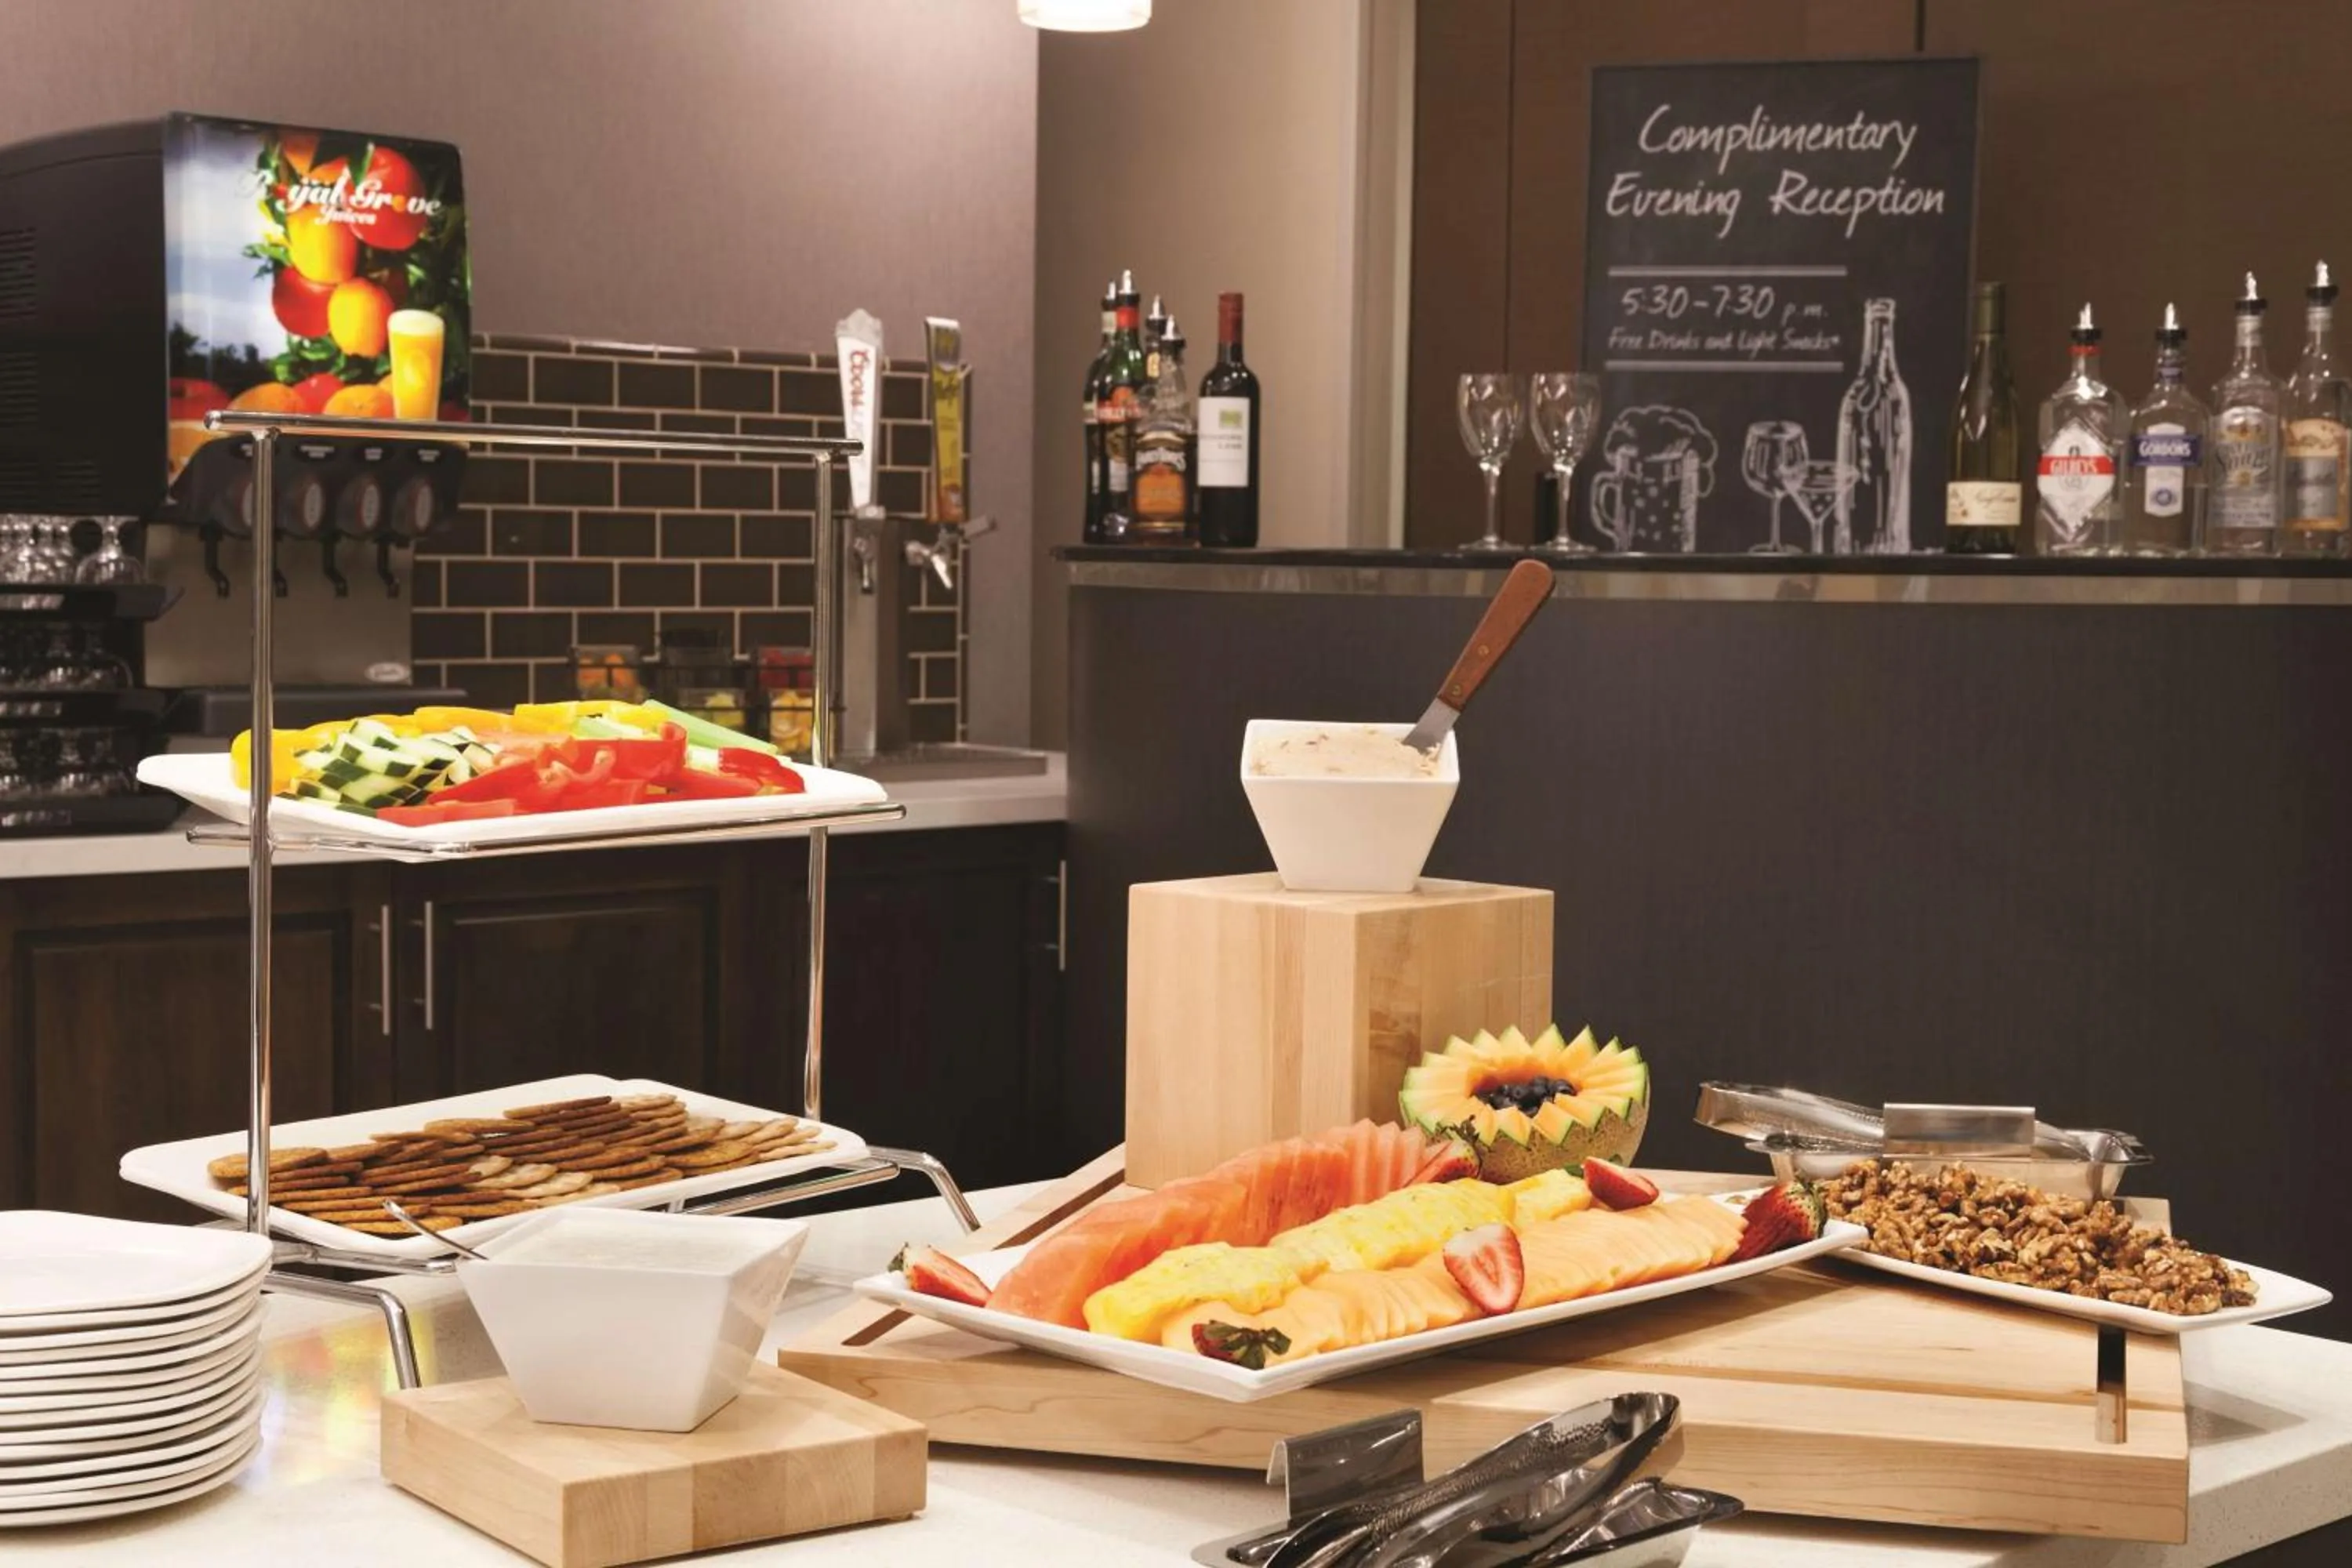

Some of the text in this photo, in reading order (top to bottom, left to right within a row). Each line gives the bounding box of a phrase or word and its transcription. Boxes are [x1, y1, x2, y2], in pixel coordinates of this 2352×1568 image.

[1639, 104, 1918, 175] Complimentary
[1606, 170, 1945, 238] Evening Reception
[1608, 326, 1643, 350] Free
[1647, 328, 1700, 350] Drinks
[1704, 332, 1734, 350] and
[1737, 328, 1777, 361] Light
